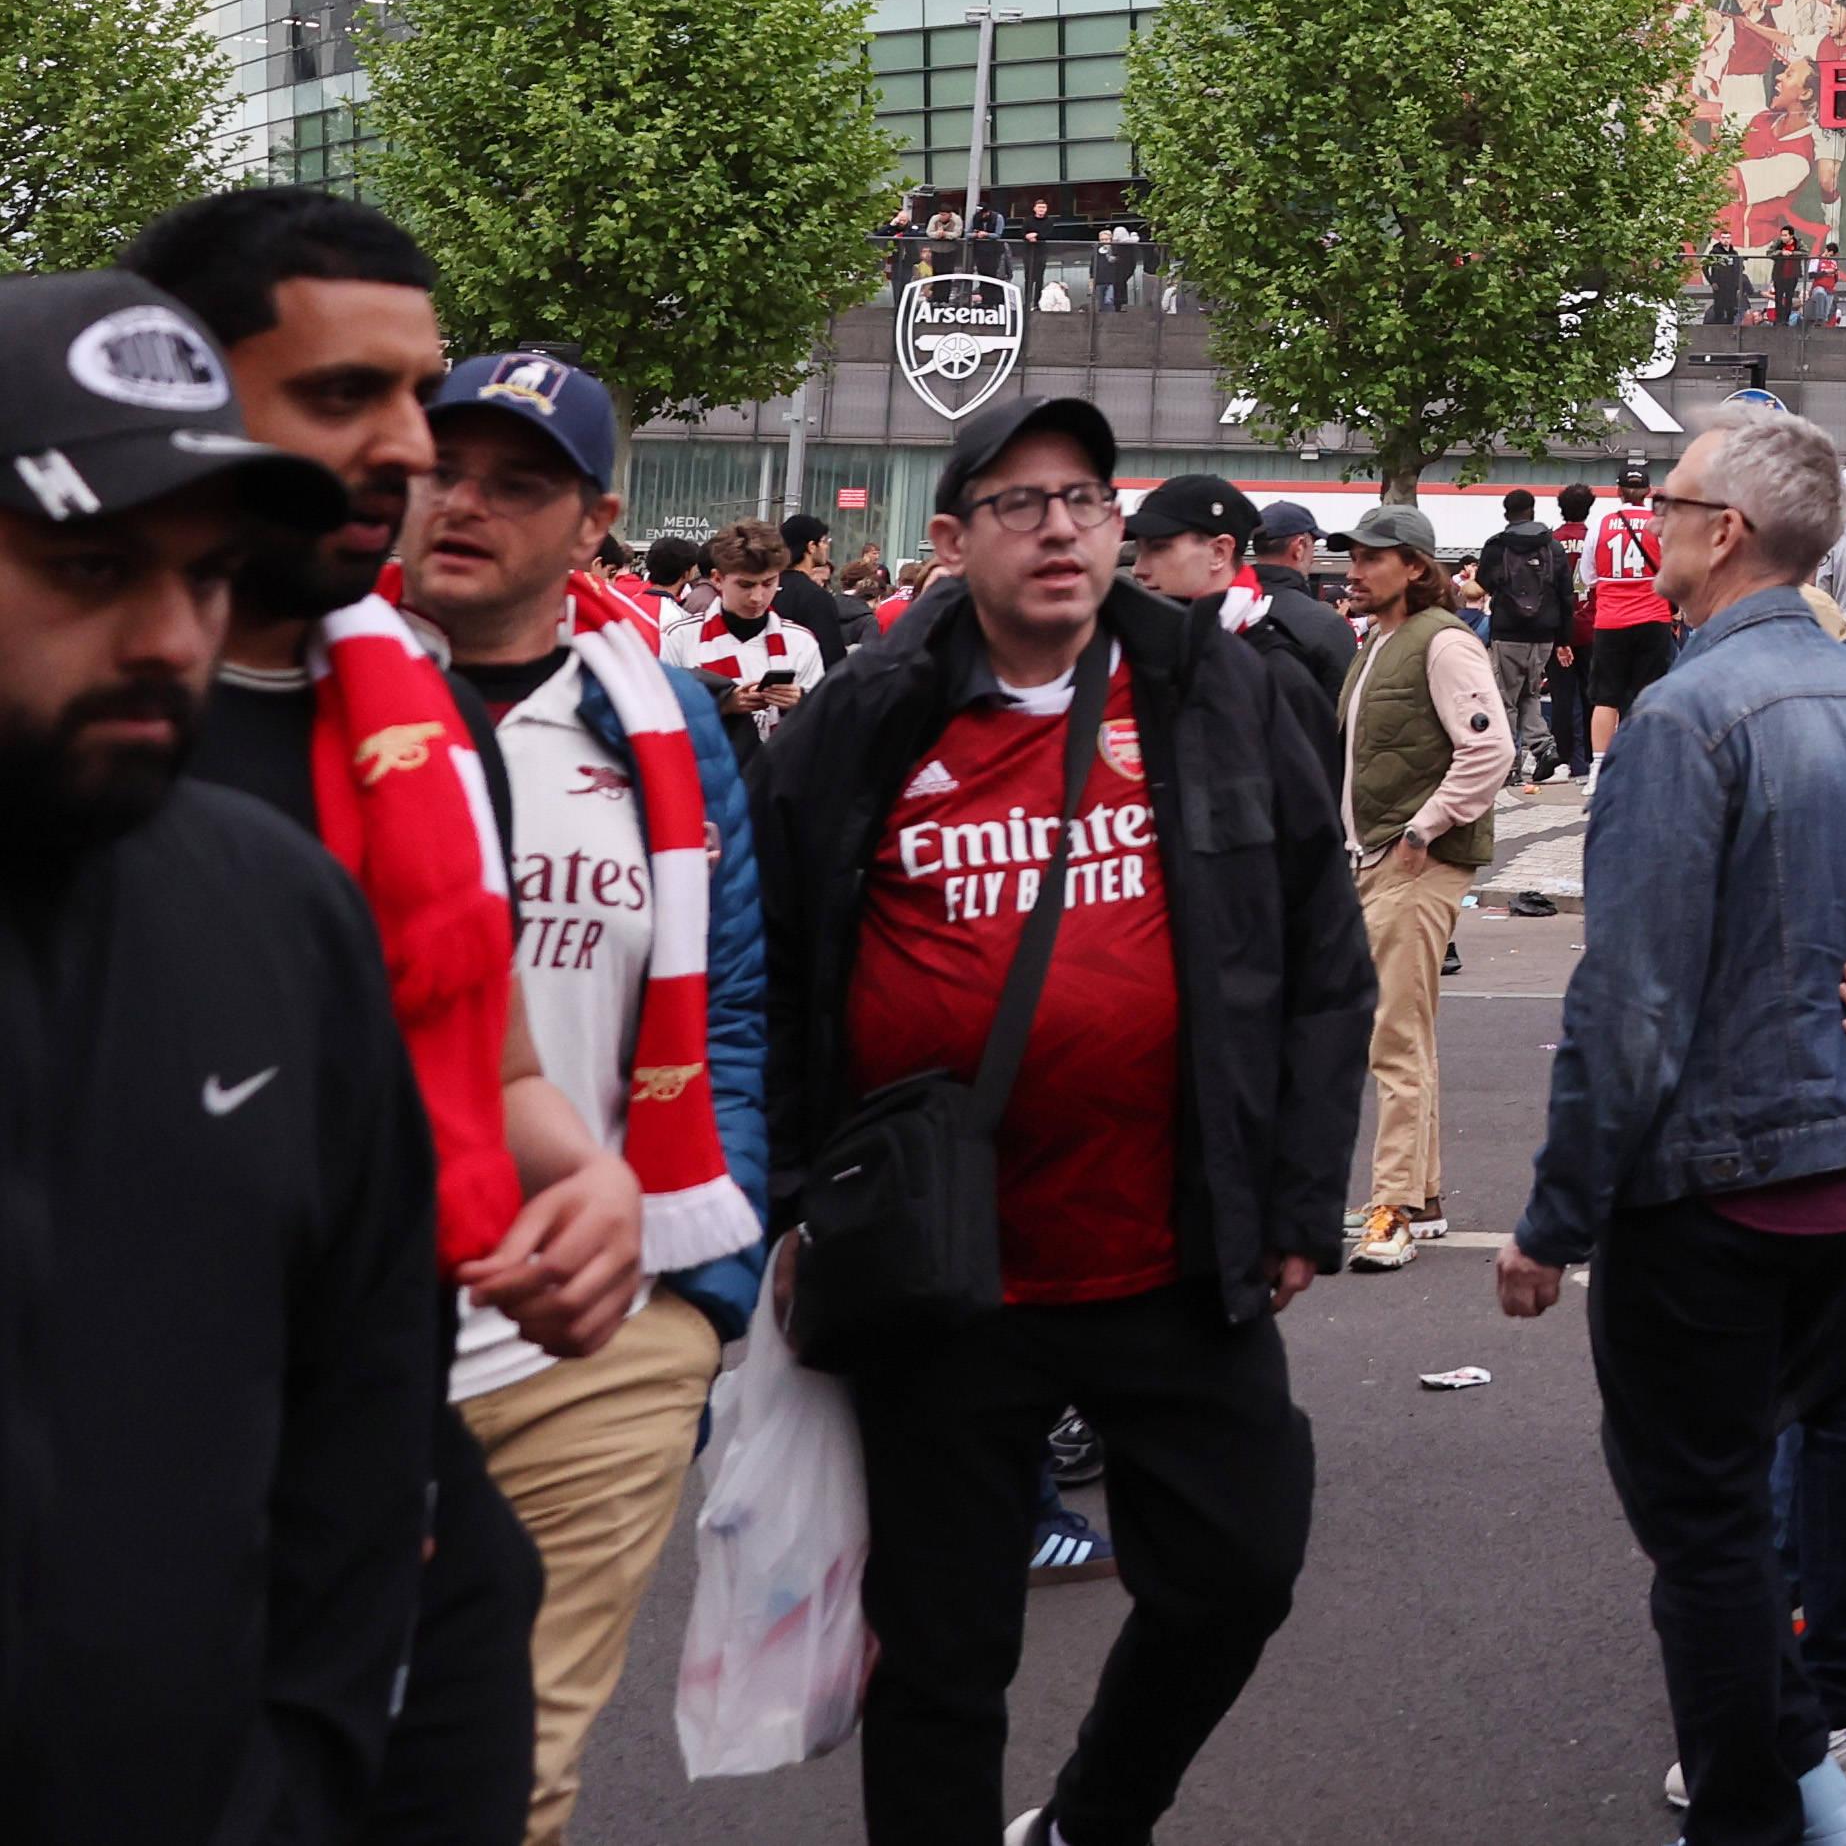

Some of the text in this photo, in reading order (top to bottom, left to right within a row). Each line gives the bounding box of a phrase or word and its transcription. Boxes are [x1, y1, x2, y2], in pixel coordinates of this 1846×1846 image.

[914, 301, 1006, 326] Arsenal
[663, 515, 710, 528] MEDIA
[1606, 532, 1645, 579] 14
[898, 802, 1157, 879] Emirate
[945, 854, 1146, 922] FLY BTTER
